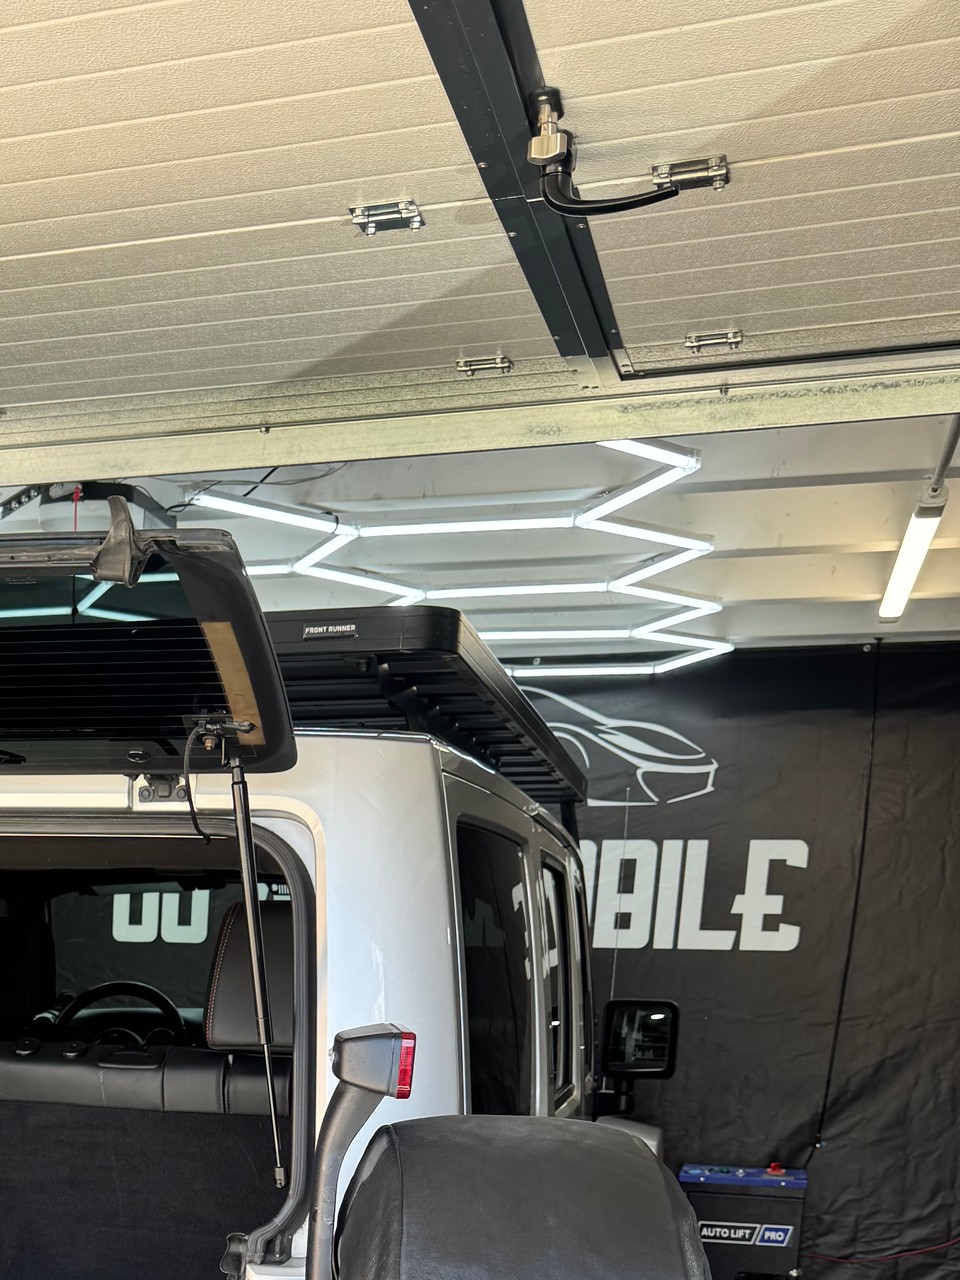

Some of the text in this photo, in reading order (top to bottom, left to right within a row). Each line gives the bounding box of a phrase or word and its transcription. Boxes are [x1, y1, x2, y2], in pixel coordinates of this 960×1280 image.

[305, 624, 356, 634] FRONT RUNNER
[579, 839, 809, 951] BILE
[700, 1227, 785, 1241] AUTO LIFT PRO
